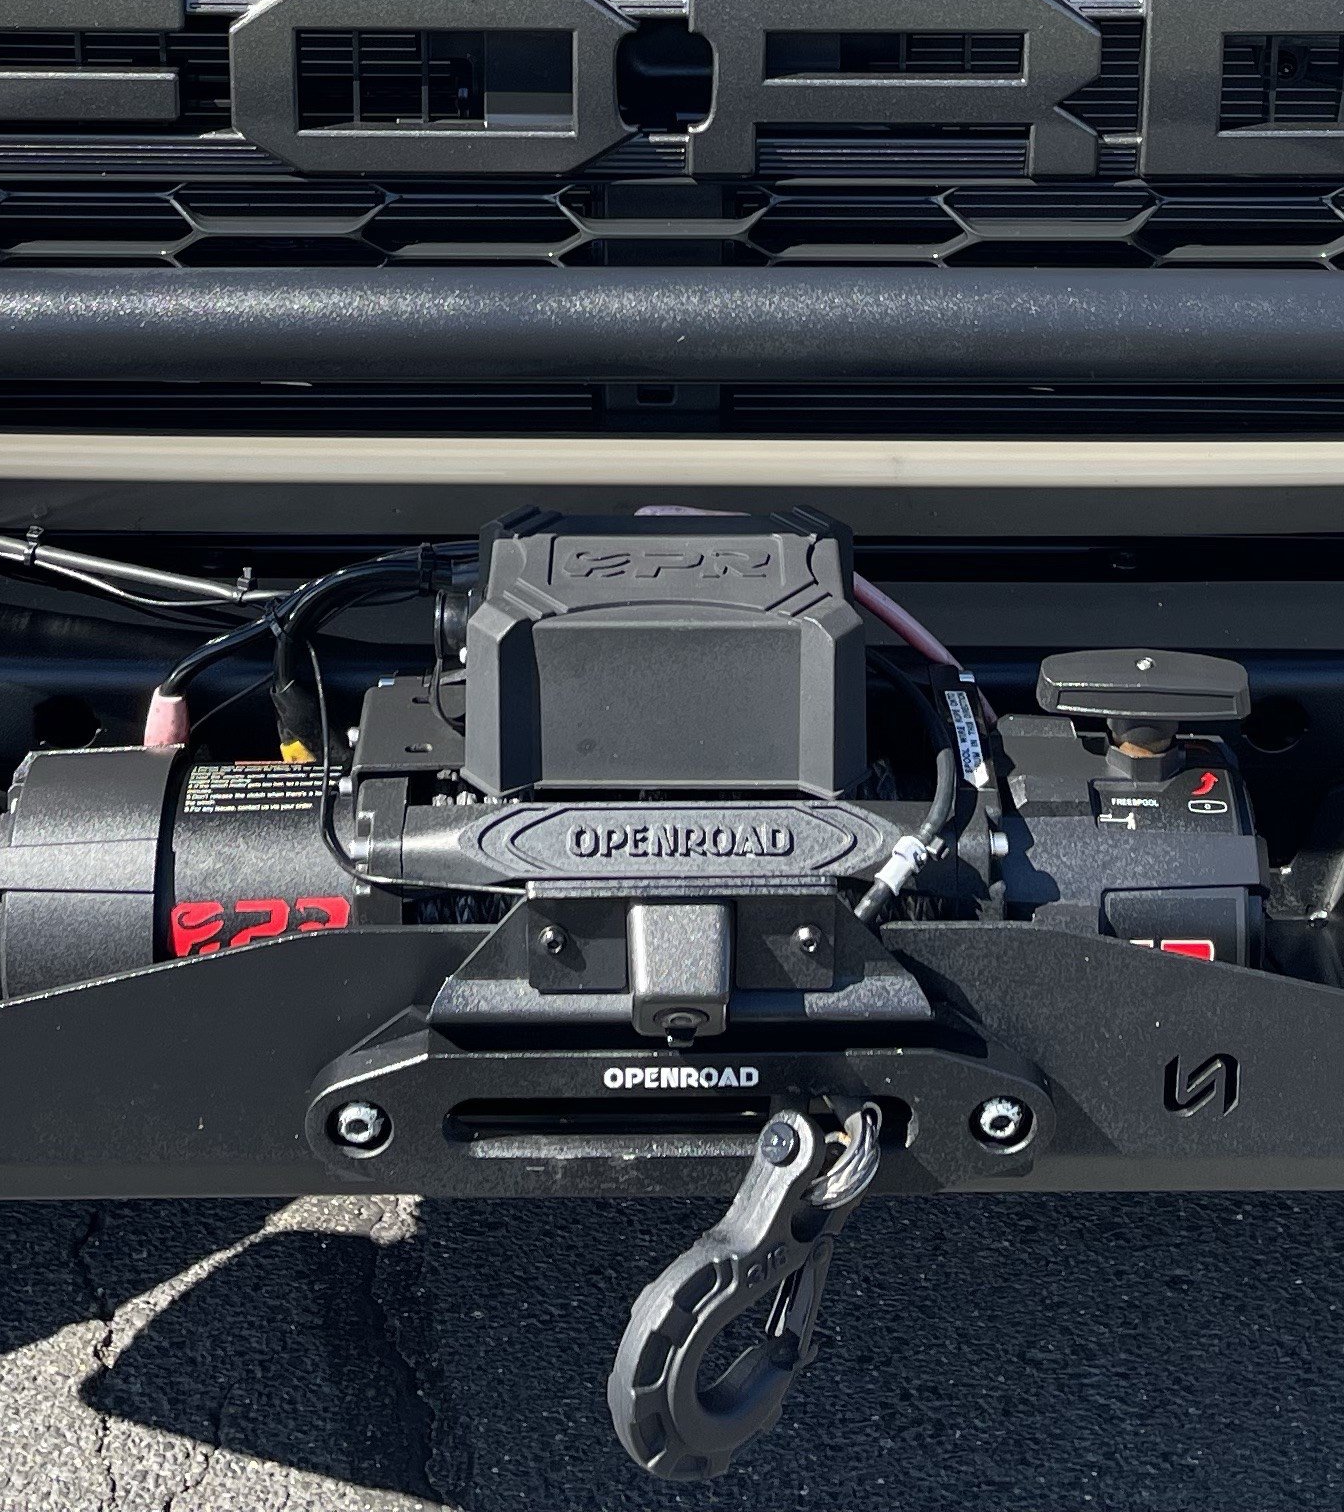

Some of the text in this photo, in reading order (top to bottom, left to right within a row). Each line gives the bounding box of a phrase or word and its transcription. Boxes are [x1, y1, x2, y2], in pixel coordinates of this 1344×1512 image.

[1111, 797, 1160, 807] FREESPOOL
[565, 823, 795, 858] OPENROAD
[602, 1066, 760, 1088] OPENROAD
